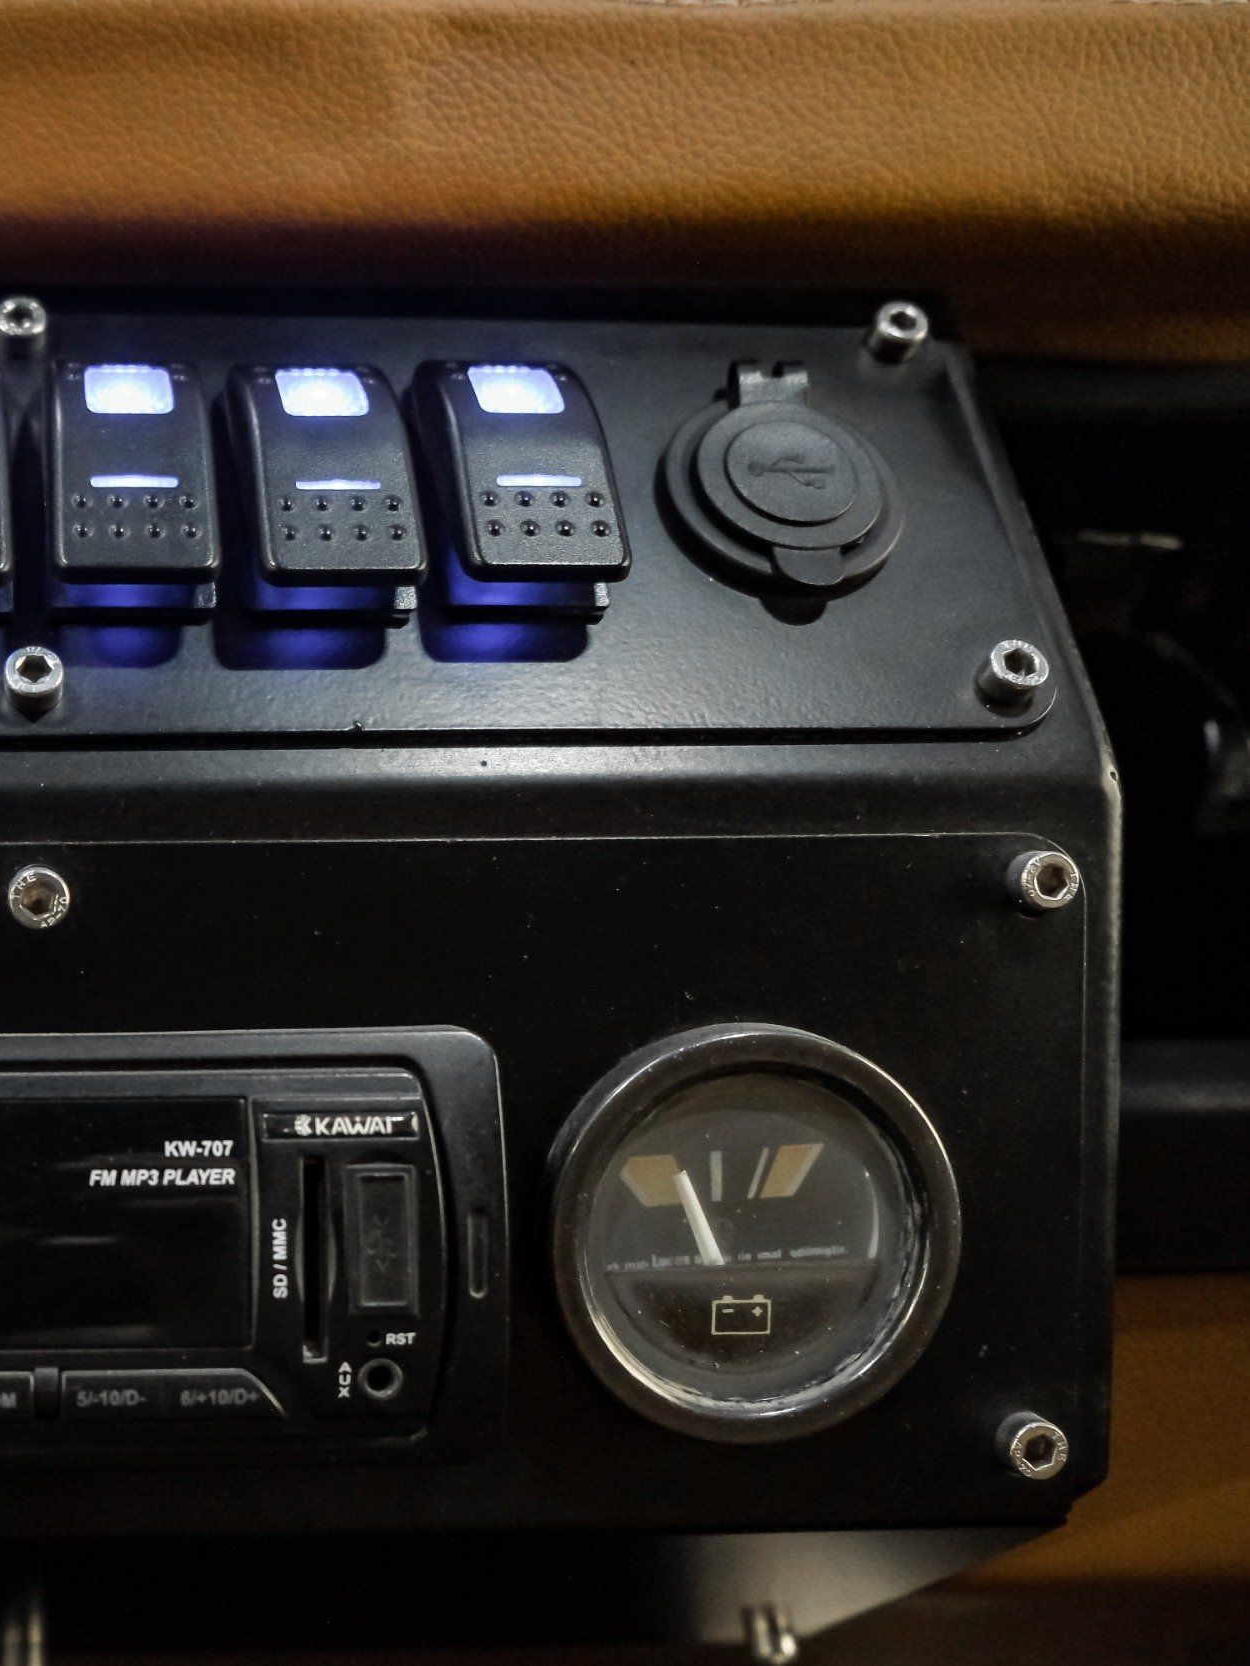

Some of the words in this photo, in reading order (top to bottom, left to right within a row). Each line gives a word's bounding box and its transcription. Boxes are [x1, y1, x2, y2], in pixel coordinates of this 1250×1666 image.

[163, 1139, 234, 1158] KW-707
[88, 1168, 118, 1187] FM
[119, 1168, 160, 1187] MP3
[162, 1167, 237, 1186] PLAYER
[385, 1331, 416, 1346] RST
[337, 1361, 353, 1398] AUX
